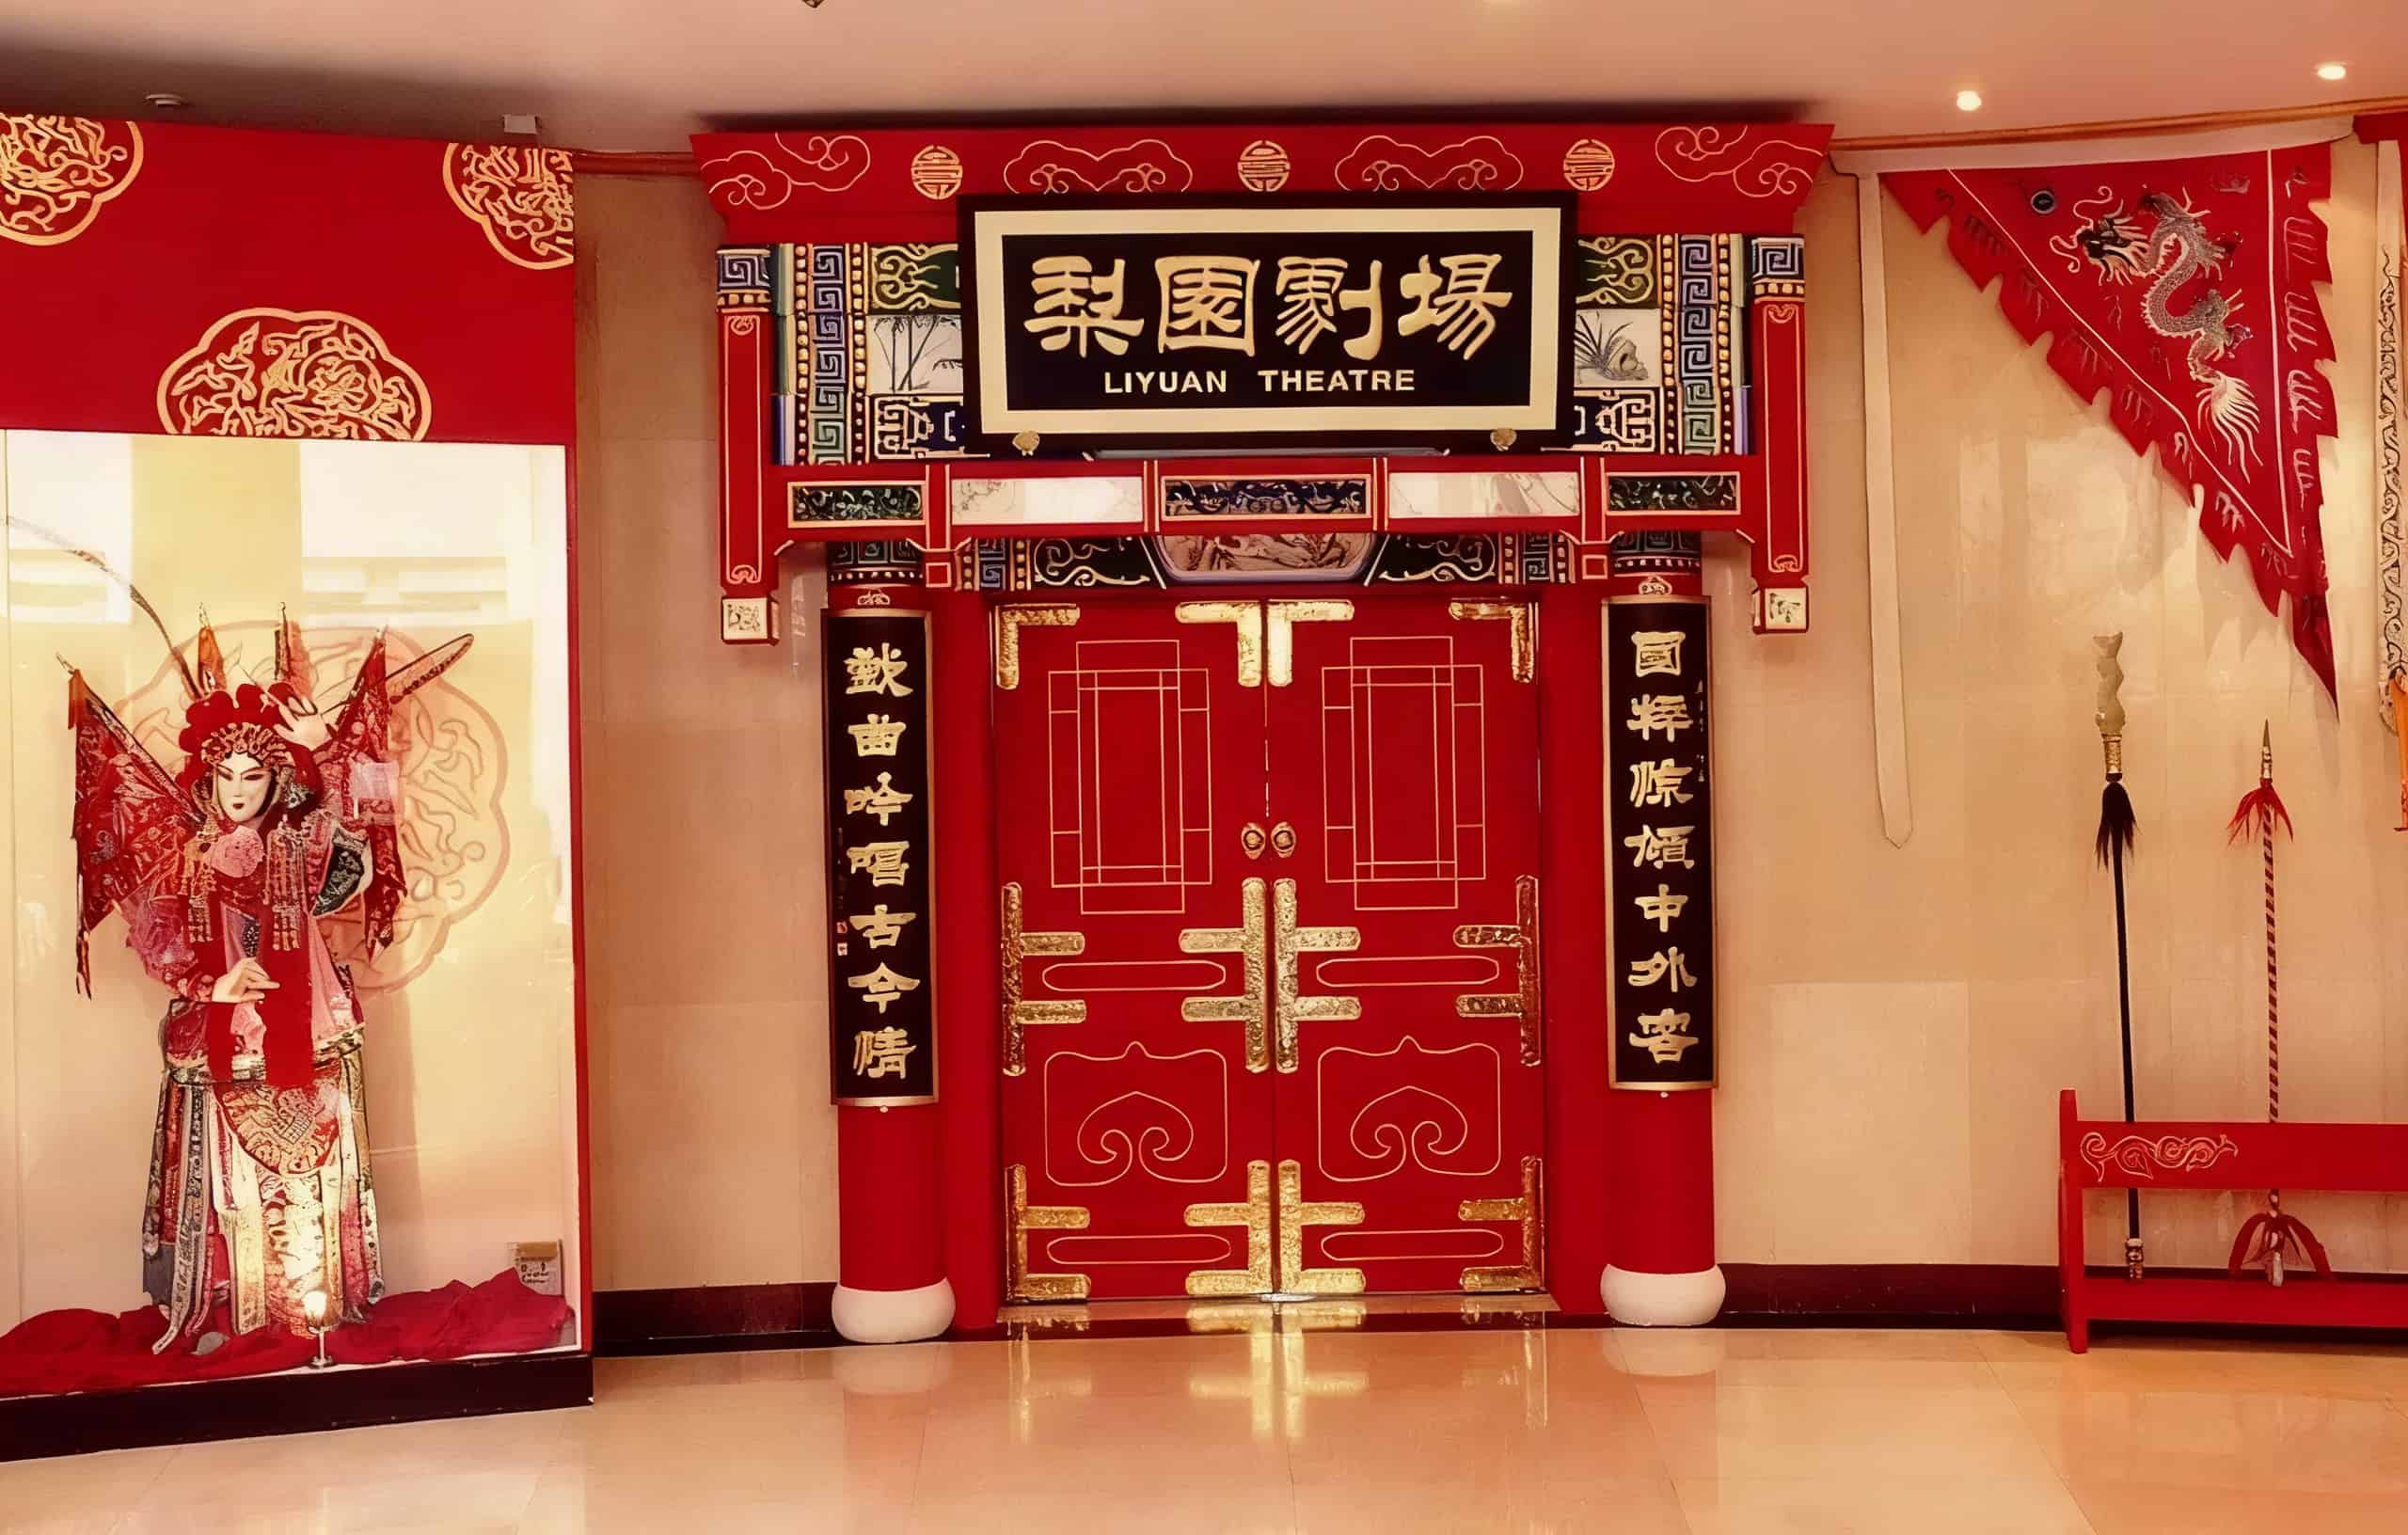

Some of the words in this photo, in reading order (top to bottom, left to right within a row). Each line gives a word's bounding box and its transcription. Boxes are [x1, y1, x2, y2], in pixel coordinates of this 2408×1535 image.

[1023, 253, 1513, 361] 梨園劇場
[1104, 370, 1228, 394] LIYUAN
[1257, 369, 1416, 392] THEATRE
